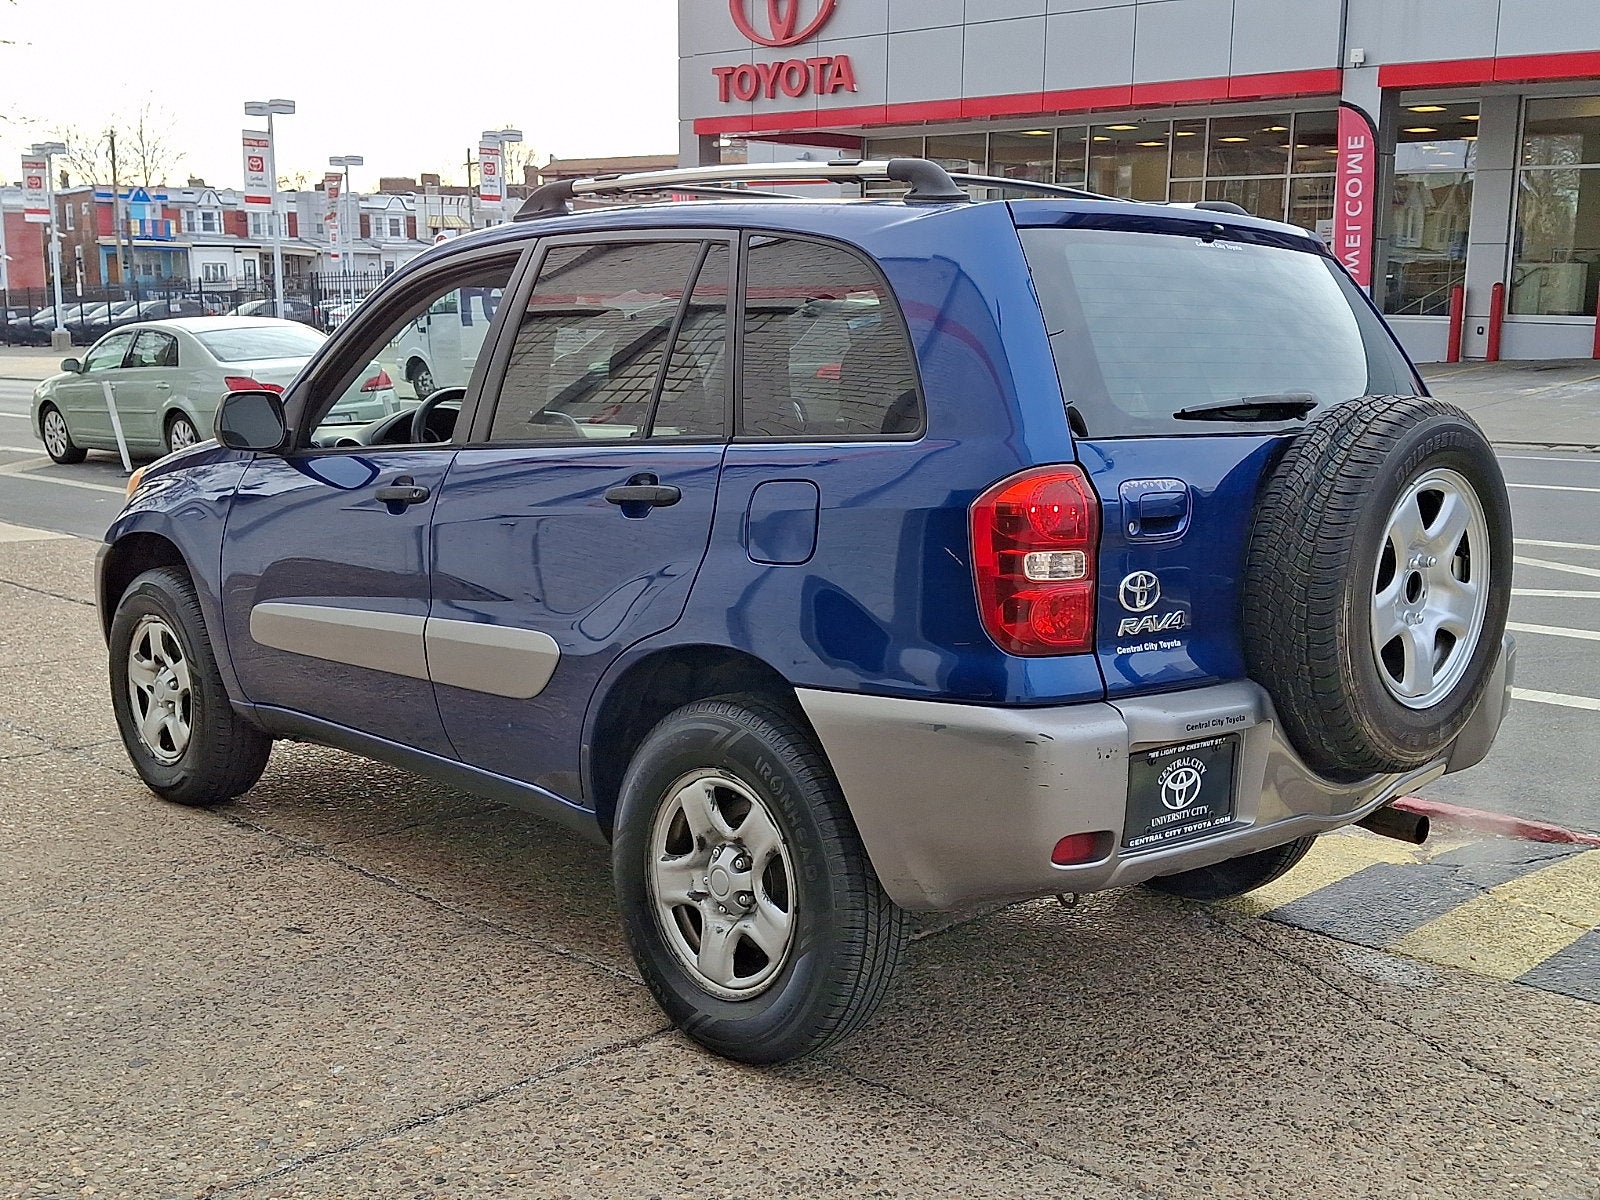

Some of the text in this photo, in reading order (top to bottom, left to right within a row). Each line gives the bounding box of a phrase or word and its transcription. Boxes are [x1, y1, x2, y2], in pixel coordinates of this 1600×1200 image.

[712, 55, 857, 102] TOYOTA
[1117, 610, 1186, 636] RAV4
[1116, 639, 1181, 654] Central City Toyota
[1186, 714, 1246, 731] Central City Toyota
[1160, 747, 1177, 756] LIGHT
[1177, 745, 1186, 753] UP
[1186, 739, 1214, 751] CHESTNUT
[1157, 757, 1208, 785] CENTRAL CITY
[1151, 805, 1209, 827] UNIVERSITY CITY
[1129, 833, 1163, 847] CENTRAL
[1164, 828, 1183, 838] CITY
[1183, 821, 1212, 833] TOYOTA
